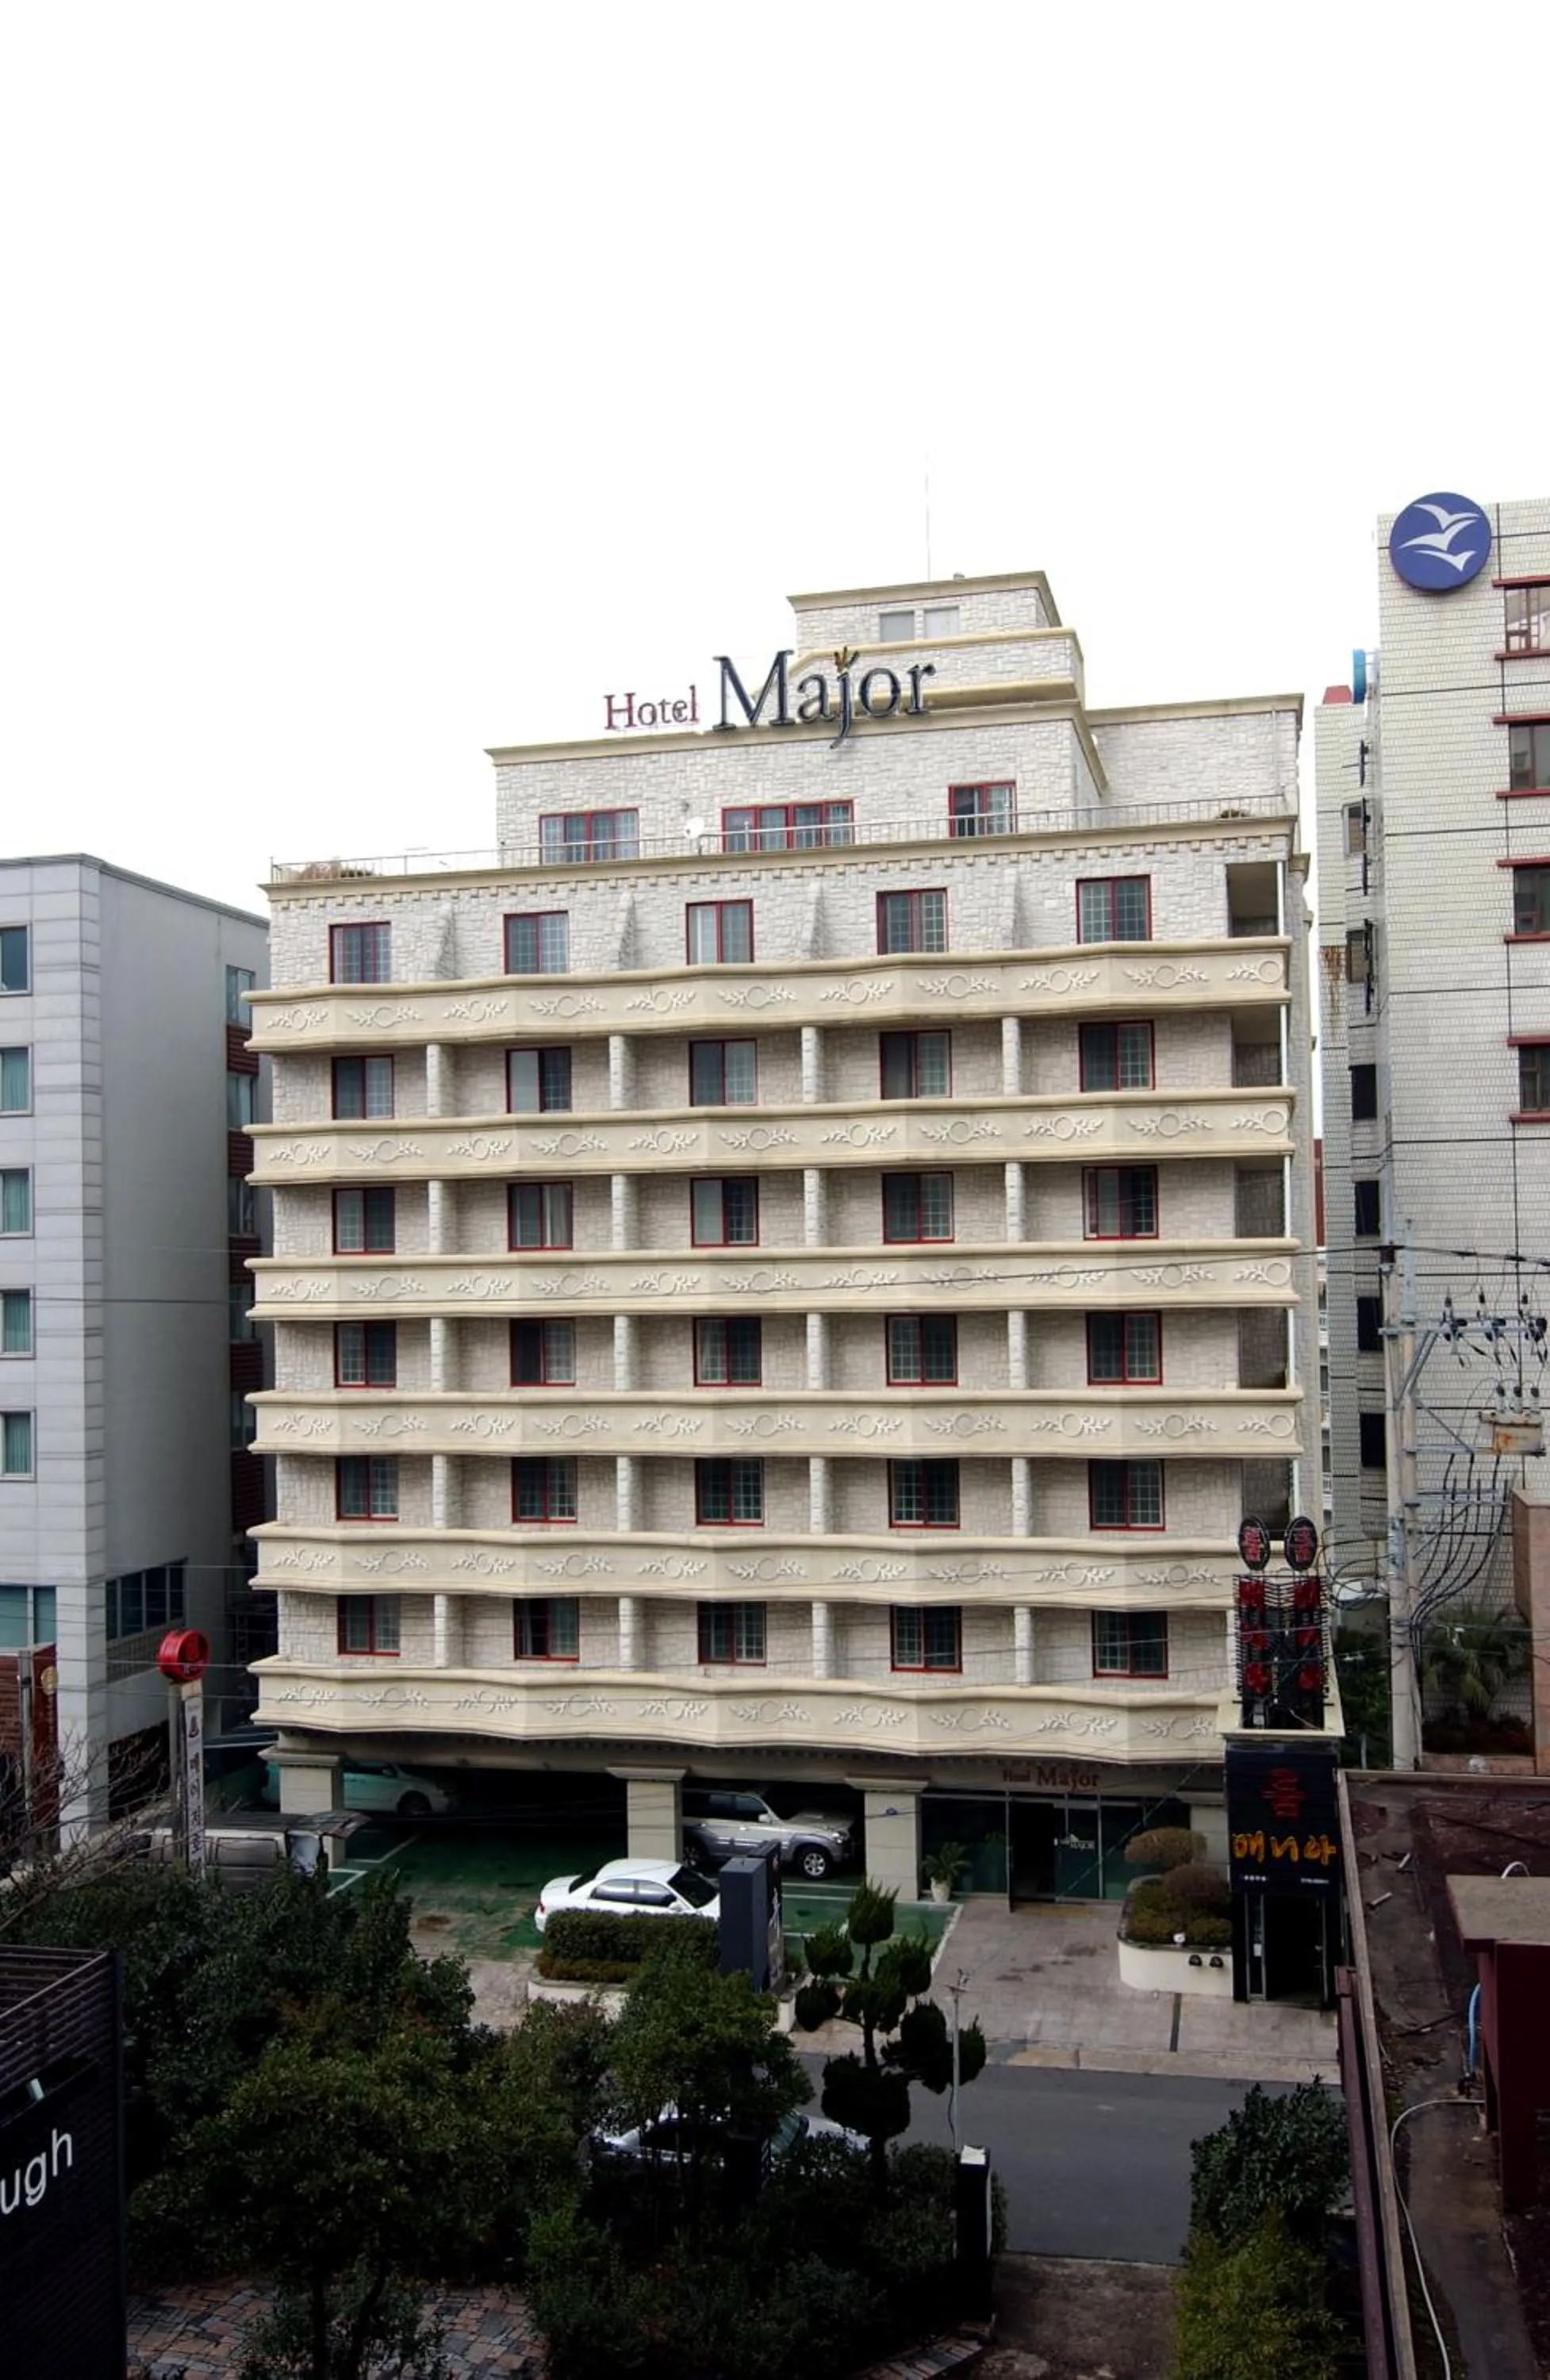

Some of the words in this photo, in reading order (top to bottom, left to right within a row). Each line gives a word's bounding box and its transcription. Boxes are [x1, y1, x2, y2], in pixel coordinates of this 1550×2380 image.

[604, 685, 700, 729] Hotel
[713, 647, 936, 749] Major
[1038, 1766, 1101, 1792] Major
[0, 2128, 73, 2215] ugh
